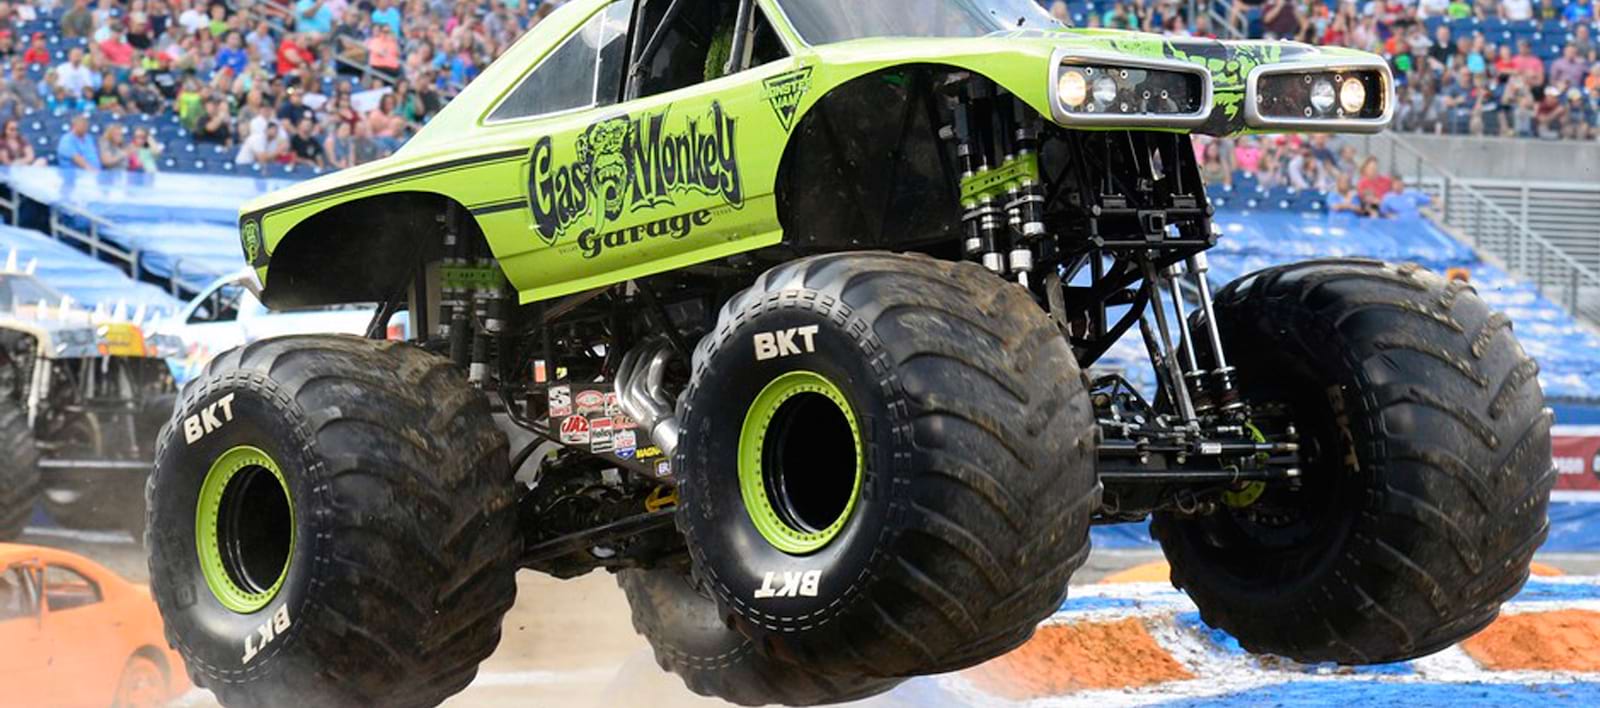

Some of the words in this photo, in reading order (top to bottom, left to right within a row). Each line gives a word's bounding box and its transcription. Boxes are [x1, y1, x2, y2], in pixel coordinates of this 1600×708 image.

[528, 135, 590, 243] Gas
[630, 101, 743, 208] Monkey
[577, 208, 713, 259] Garage
[753, 325, 819, 361] BKT
[183, 392, 235, 445] BKT
[754, 570, 822, 598] BKT
[241, 602, 291, 664] BKT
